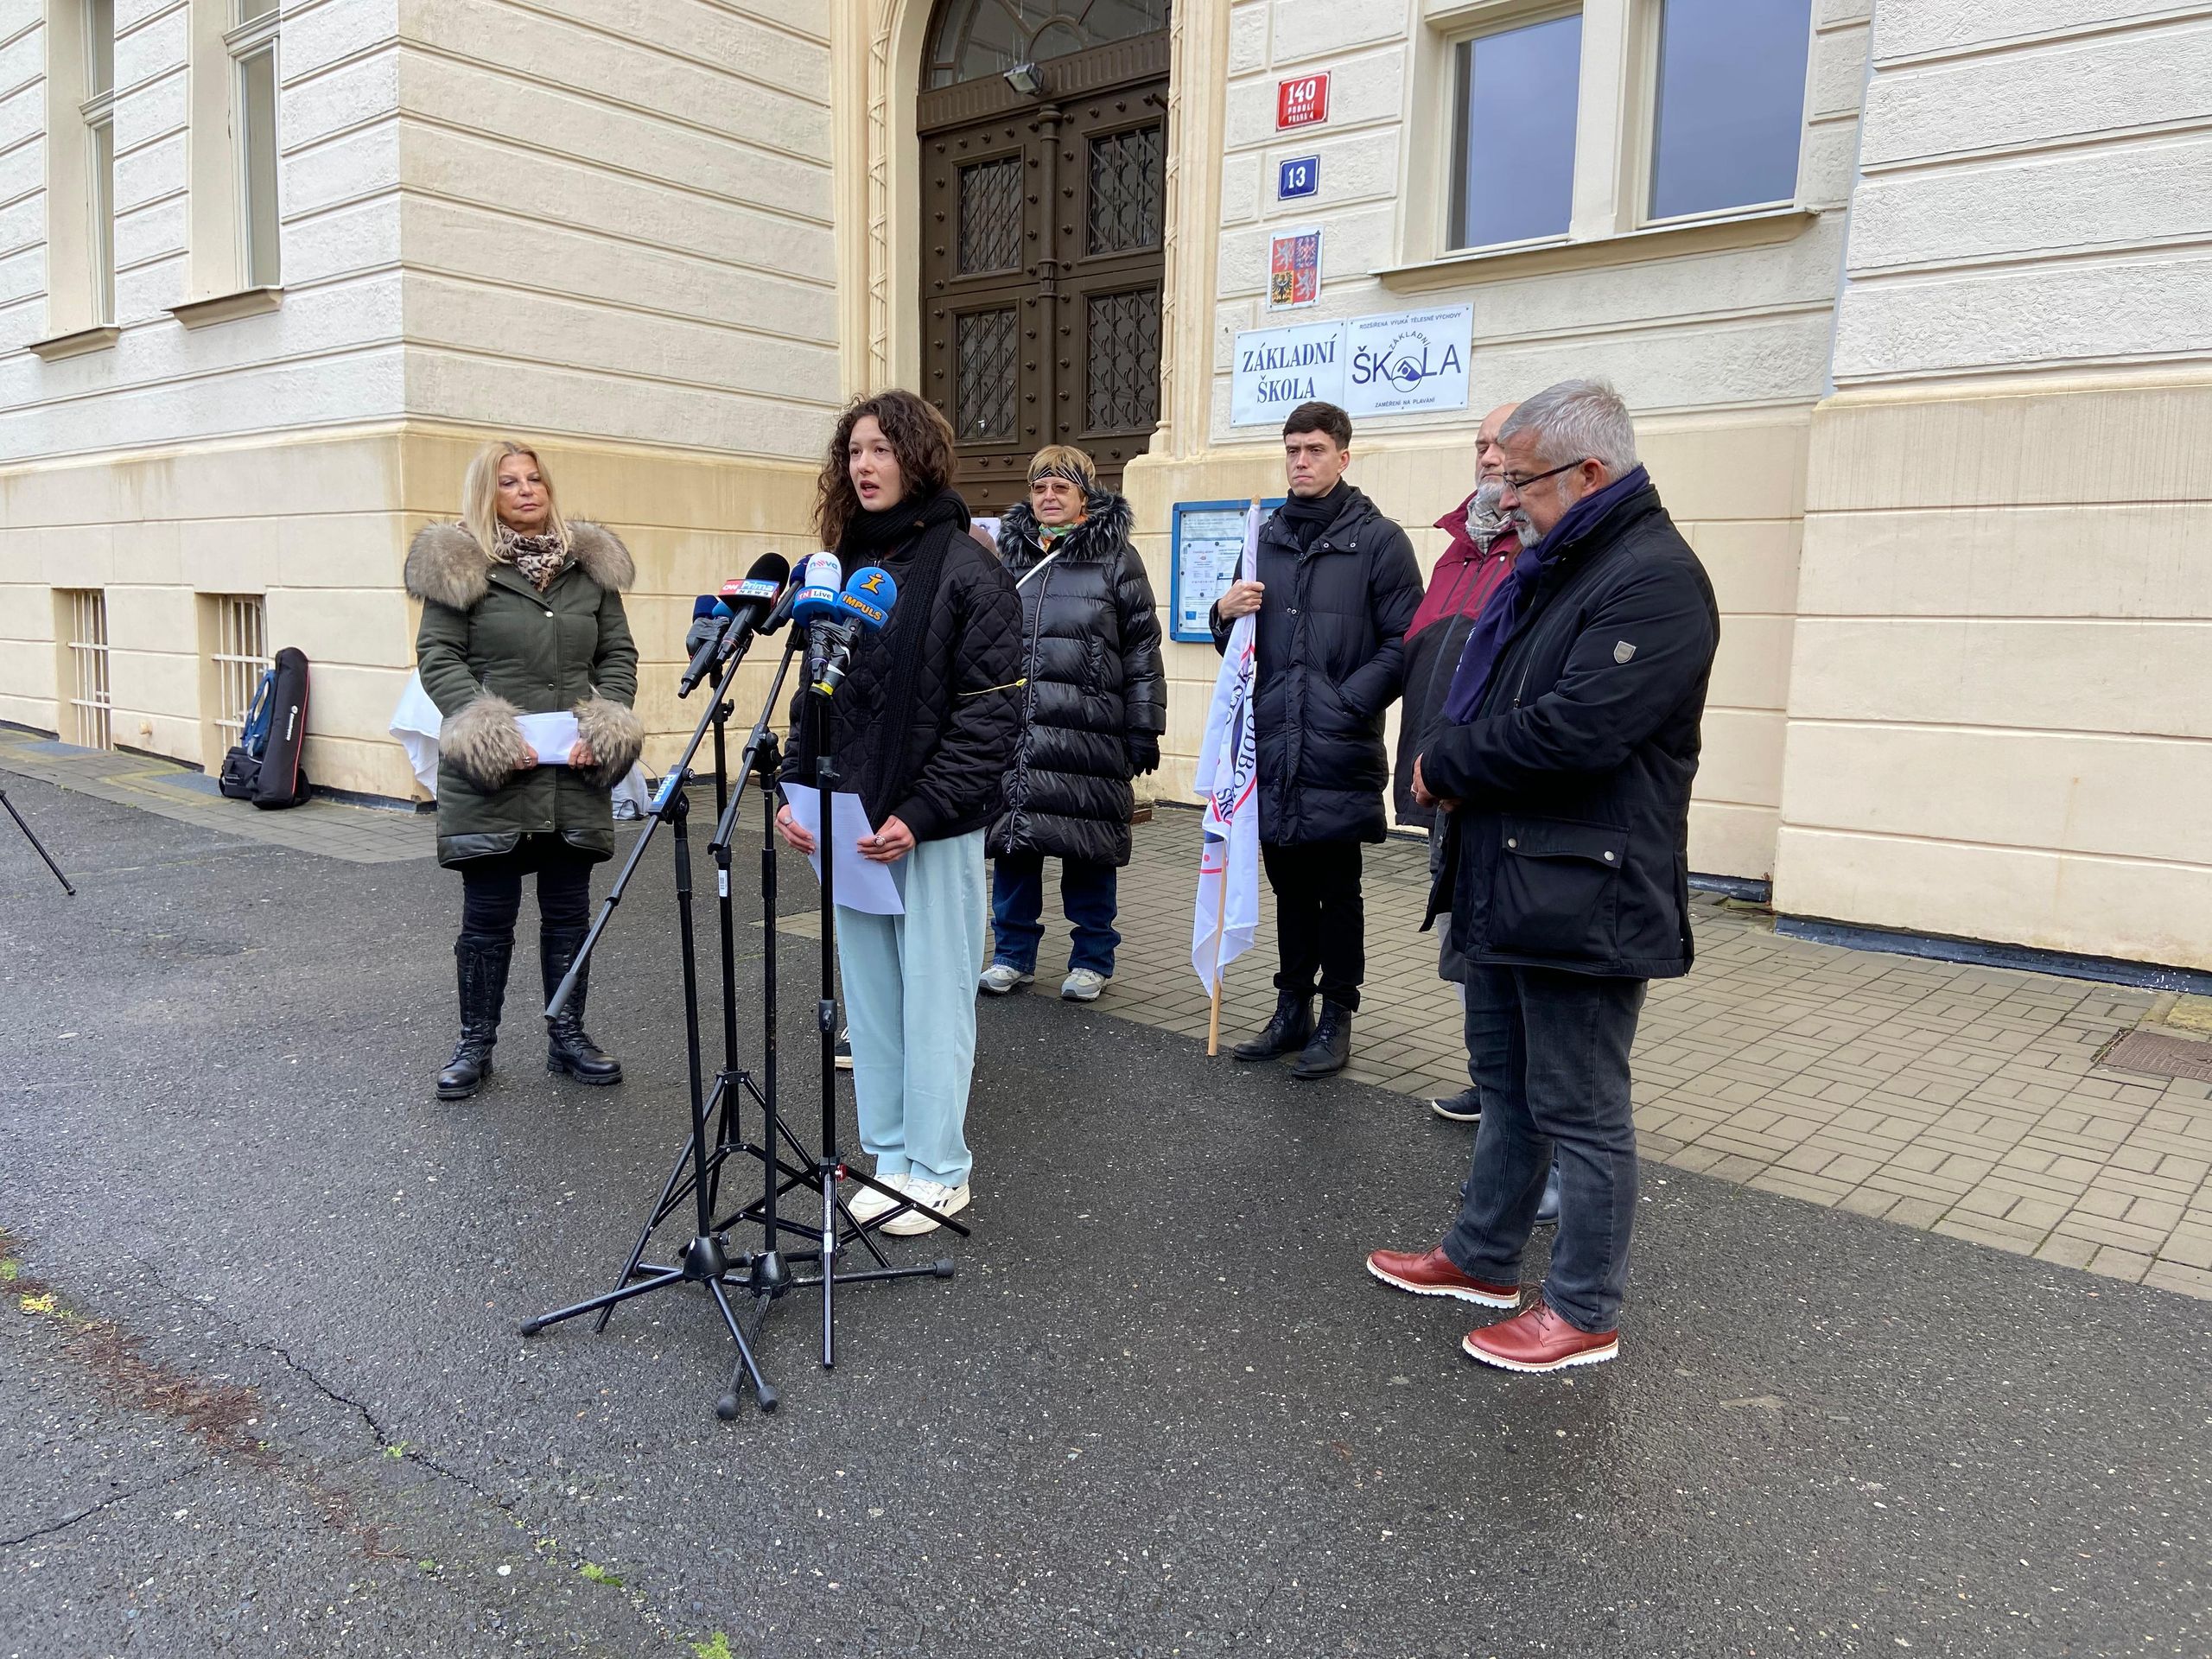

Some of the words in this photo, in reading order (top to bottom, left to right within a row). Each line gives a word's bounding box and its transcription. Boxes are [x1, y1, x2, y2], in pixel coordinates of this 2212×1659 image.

[1288, 80, 1316, 105] 140
[1288, 167, 1306, 188] 13
[1243, 334, 1337, 372] ZÁKLADNÍ
[1257, 375, 1316, 404] ŠKOLA
[810, 559, 838, 570] nova
[741, 580, 774, 592] Prima
[798, 591, 810, 601] TN
[813, 590, 831, 600] Live
[842, 594, 882, 621] IMPULS
[653, 773, 677, 803] Prima
